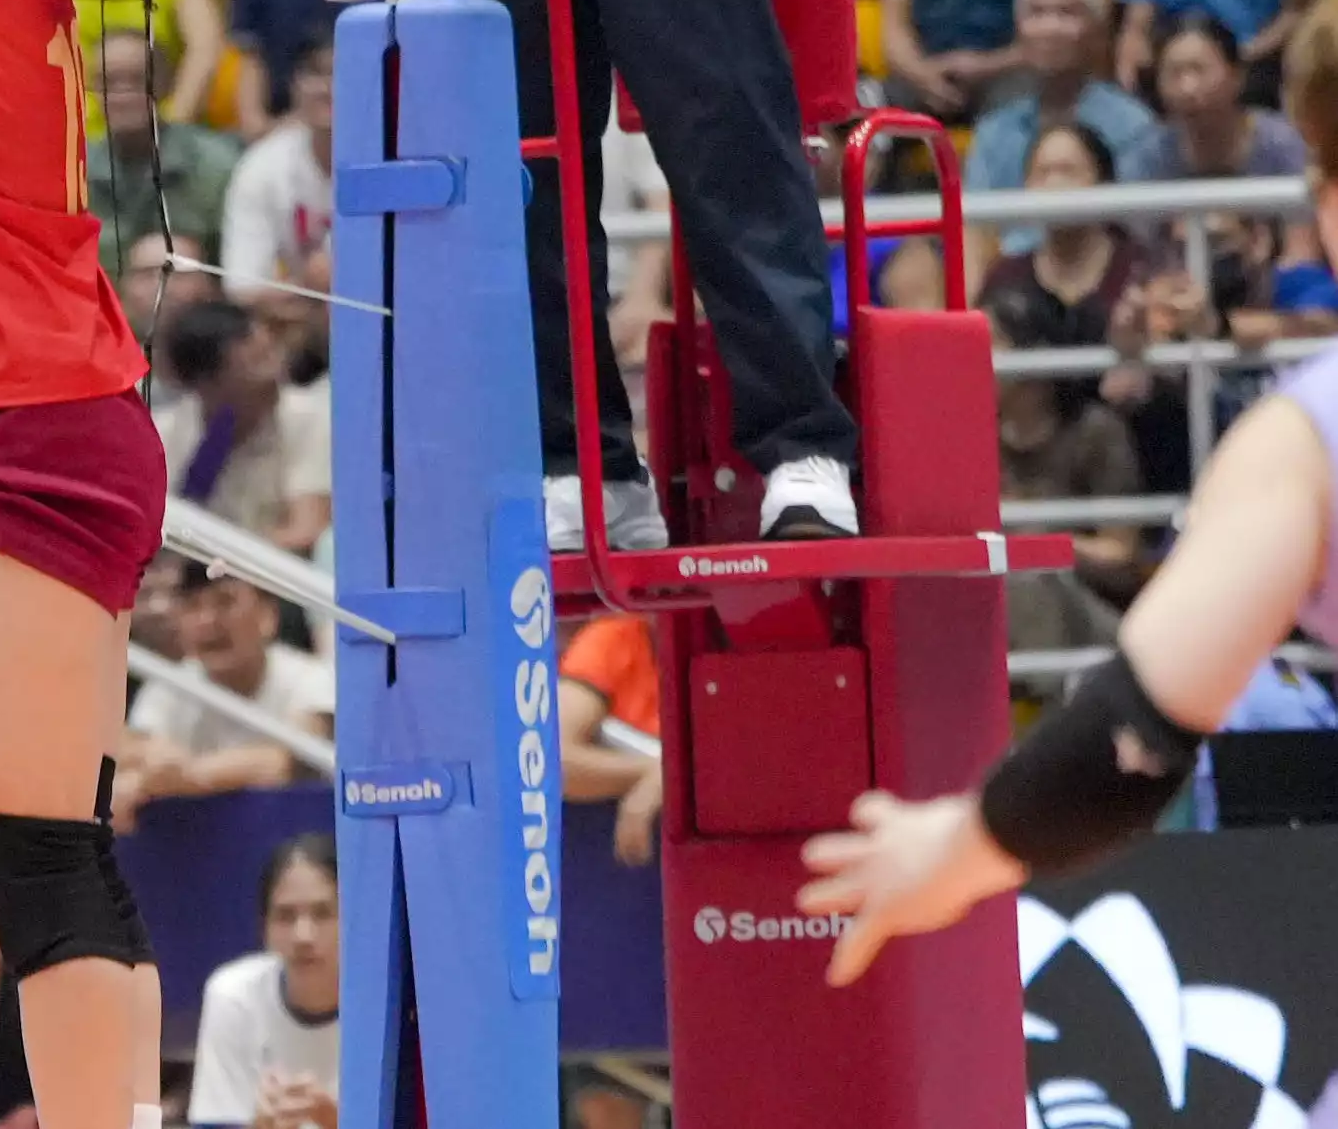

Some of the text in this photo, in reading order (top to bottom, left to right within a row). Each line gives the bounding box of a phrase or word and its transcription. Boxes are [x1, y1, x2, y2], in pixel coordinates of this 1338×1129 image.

[46, 19, 88, 215] 1
[697, 554, 768, 577] Senoh
[361, 778, 442, 805] Senoh
[514, 659, 558, 976] Senoh
[729, 911, 856, 942] Senoh
